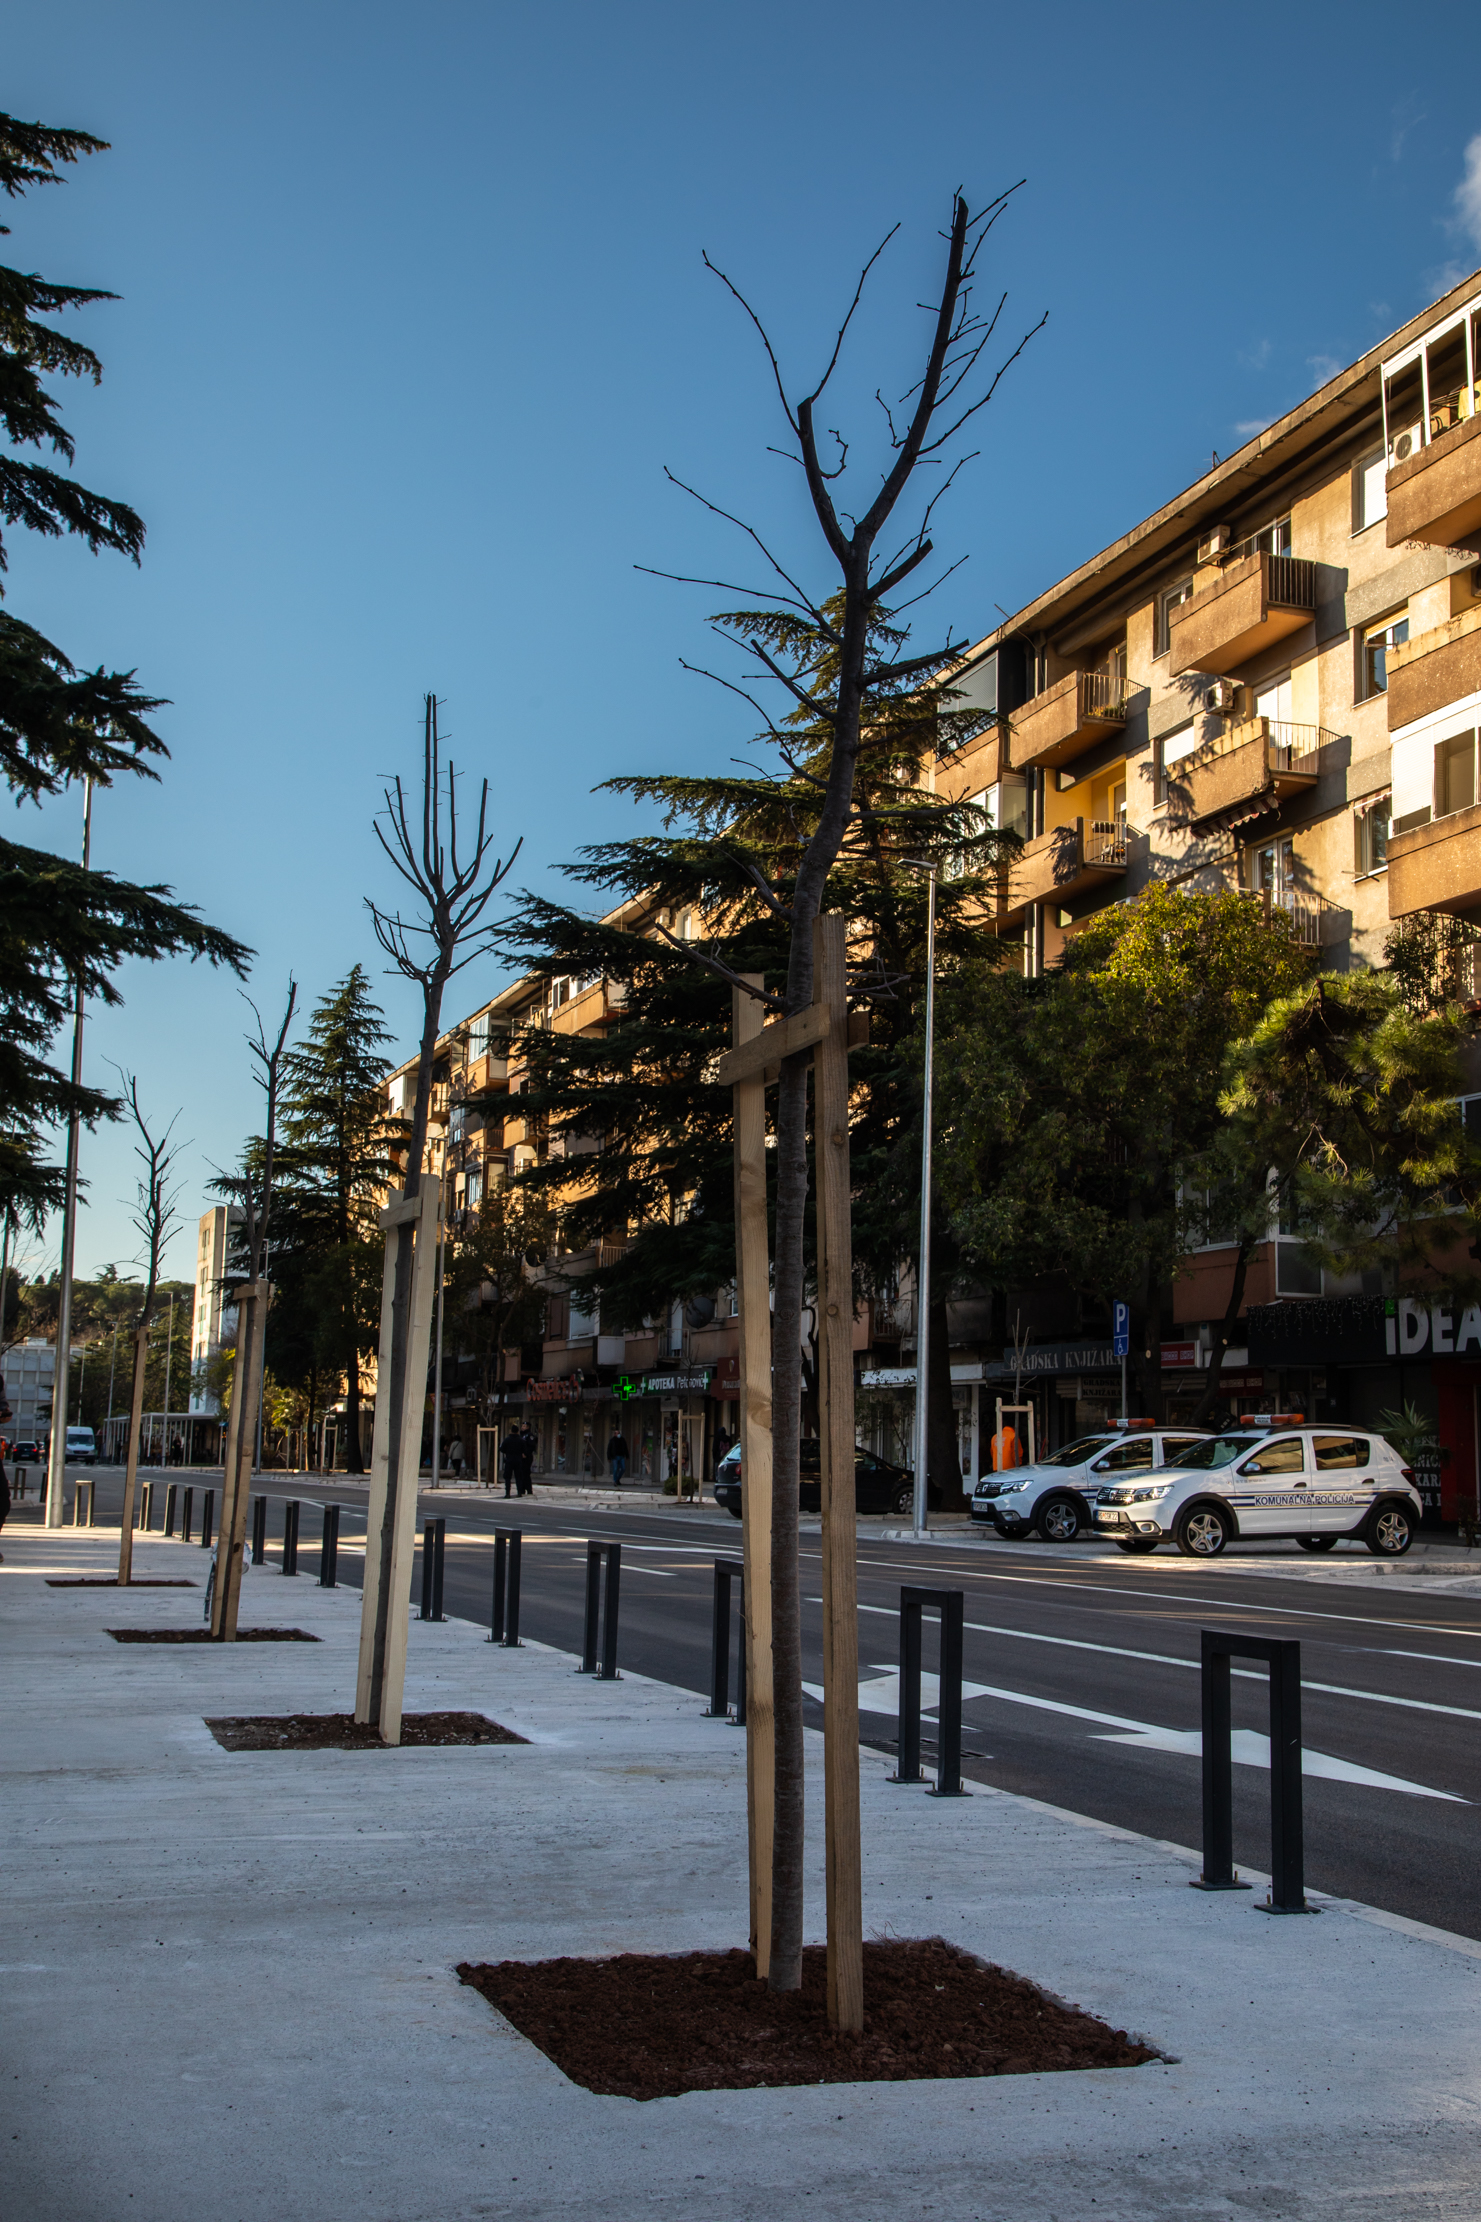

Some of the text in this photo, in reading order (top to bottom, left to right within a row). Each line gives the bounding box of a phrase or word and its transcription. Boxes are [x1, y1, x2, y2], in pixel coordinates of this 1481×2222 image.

[1116, 1303, 1126, 1333] P
[647, 1377, 675, 1391] APOTEKA
[1255, 1494, 1355, 1506] KOMUNALNA POLICIJA
